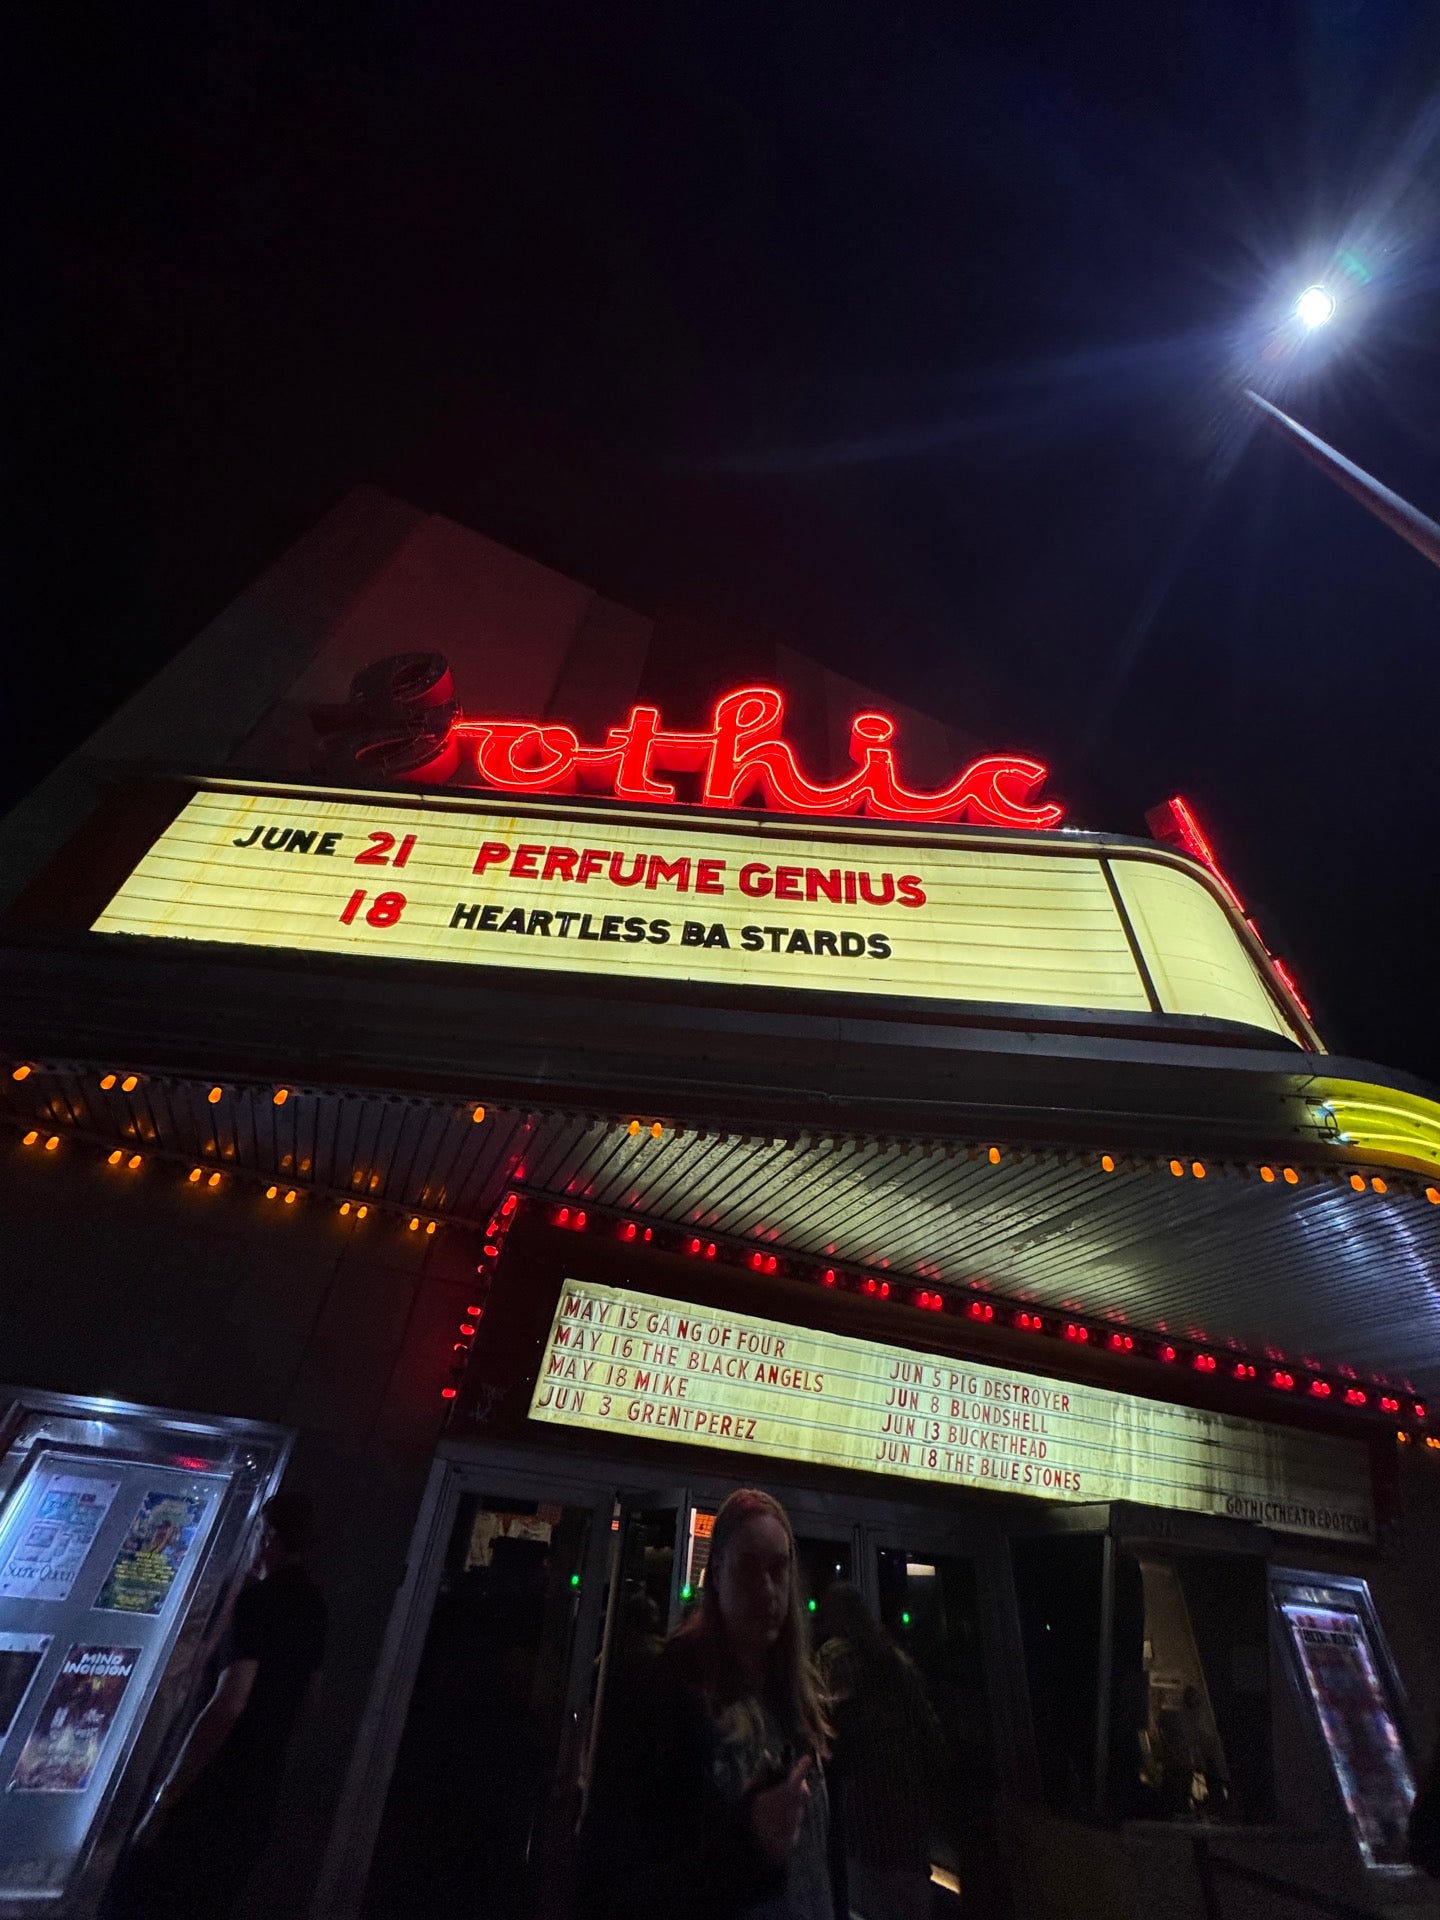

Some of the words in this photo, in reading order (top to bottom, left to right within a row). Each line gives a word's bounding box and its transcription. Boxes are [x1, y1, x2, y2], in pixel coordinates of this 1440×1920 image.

[232, 824, 344, 857] JUNE
[354, 831, 418, 868] 21
[472, 841, 727, 896] PERFUME
[738, 862, 928, 908] GENIUS
[338, 888, 408, 929] 18
[448, 902, 672, 946] HEARTLESS
[563, 1294, 609, 1324] MAY
[618, 1307, 639, 1330] 15
[736, 1330, 786, 1359] FOUR
[546, 1351, 595, 1382] MAY
[604, 1364, 628, 1388] 18
[634, 1370, 690, 1399] MIKE
[554, 1324, 603, 1352] MAY
[611, 1338, 634, 1358] 16
[642, 1340, 680, 1367] THE
[687, 1350, 750, 1381] BLACK
[754, 1362, 825, 1394] ANGELS
[537, 1384, 586, 1413] JUN
[597, 1395, 612, 1417] 3
[885, 1387, 919, 1411] JUN
[930, 1395, 940, 1414] 8
[950, 1399, 1049, 1435] BLONDSHELL
[890, 1361, 924, 1385] JUN
[932, 1370, 942, 1388] 5
[950, 1371, 978, 1395] PIG
[984, 1379, 1071, 1413] DESTROYER
[881, 1413, 916, 1438] JUN
[923, 1420, 941, 1441] 13
[948, 1425, 1048, 1460] BUCKETHEAD
[875, 1441, 911, 1464] JUN
[920, 1447, 938, 1469] 18
[945, 1451, 974, 1474] THE
[980, 1457, 1020, 1482] BLUE
[1023, 1464, 1082, 1492] STONES
